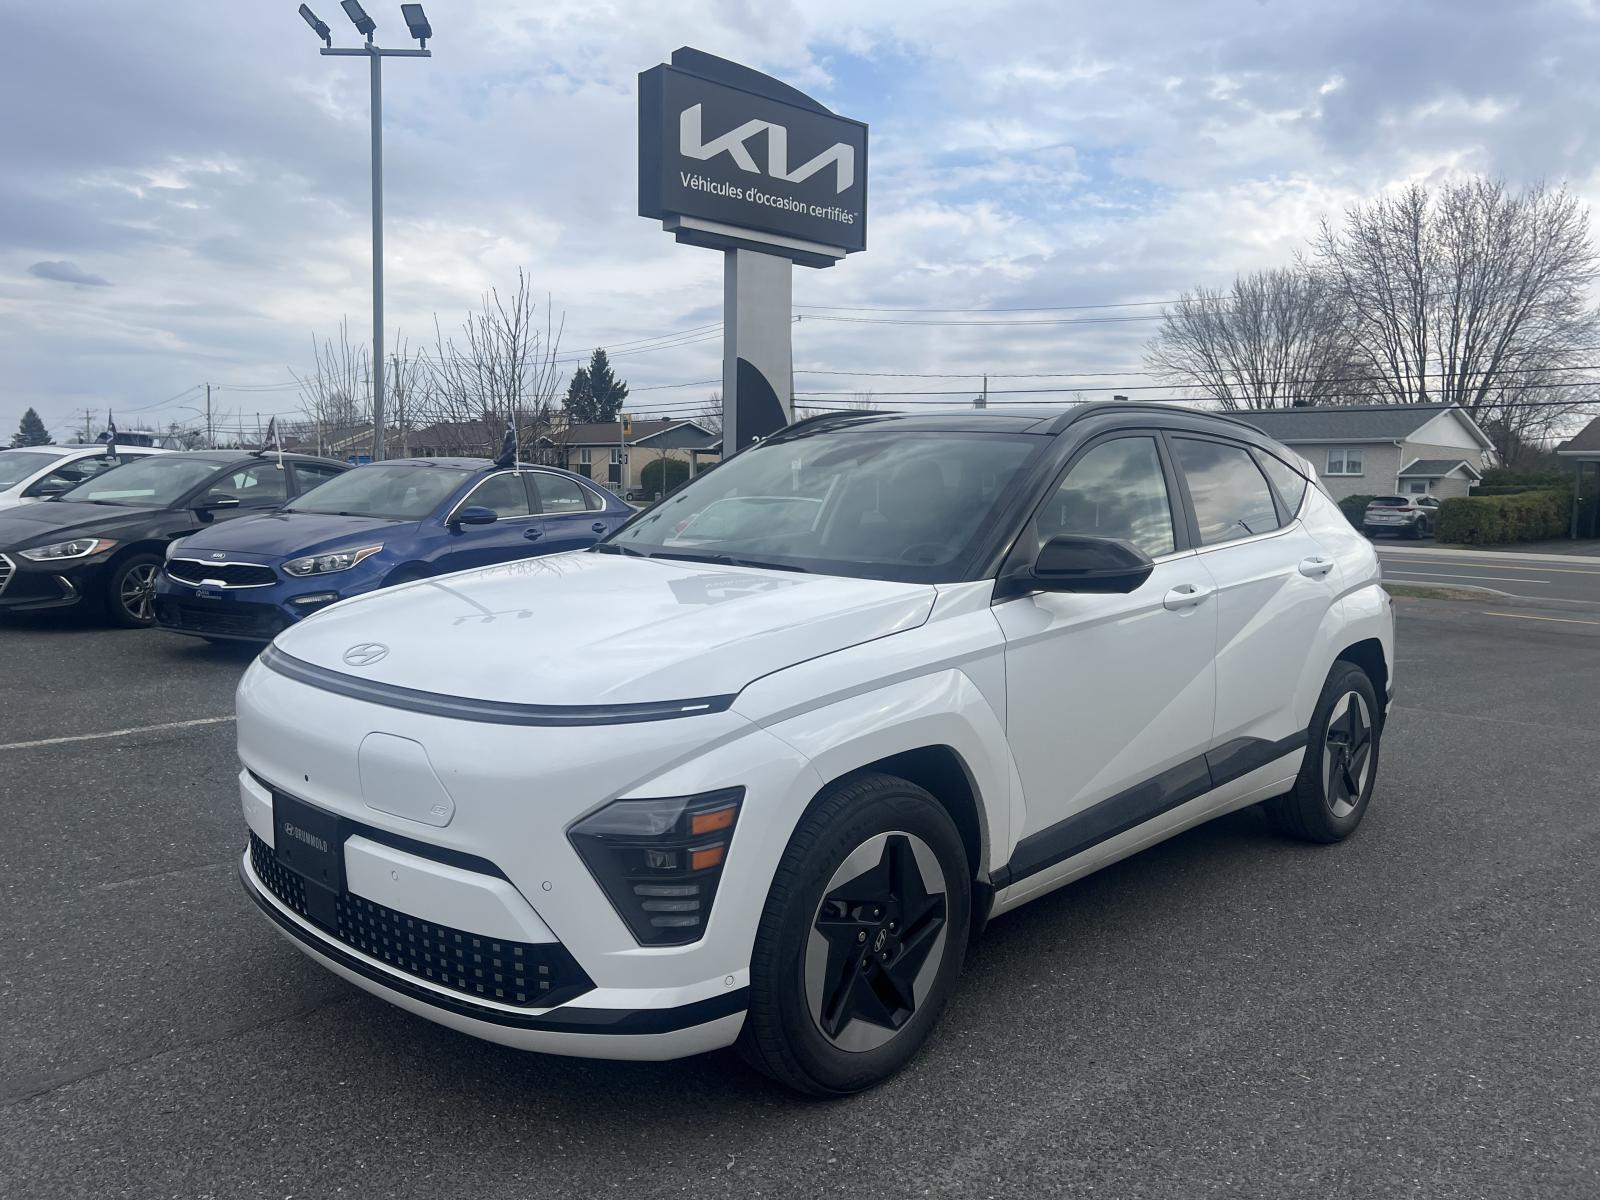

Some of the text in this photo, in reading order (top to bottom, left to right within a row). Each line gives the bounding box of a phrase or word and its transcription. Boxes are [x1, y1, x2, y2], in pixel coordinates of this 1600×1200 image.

[680, 171, 854, 225] Véhicules d'occasion certifiés
